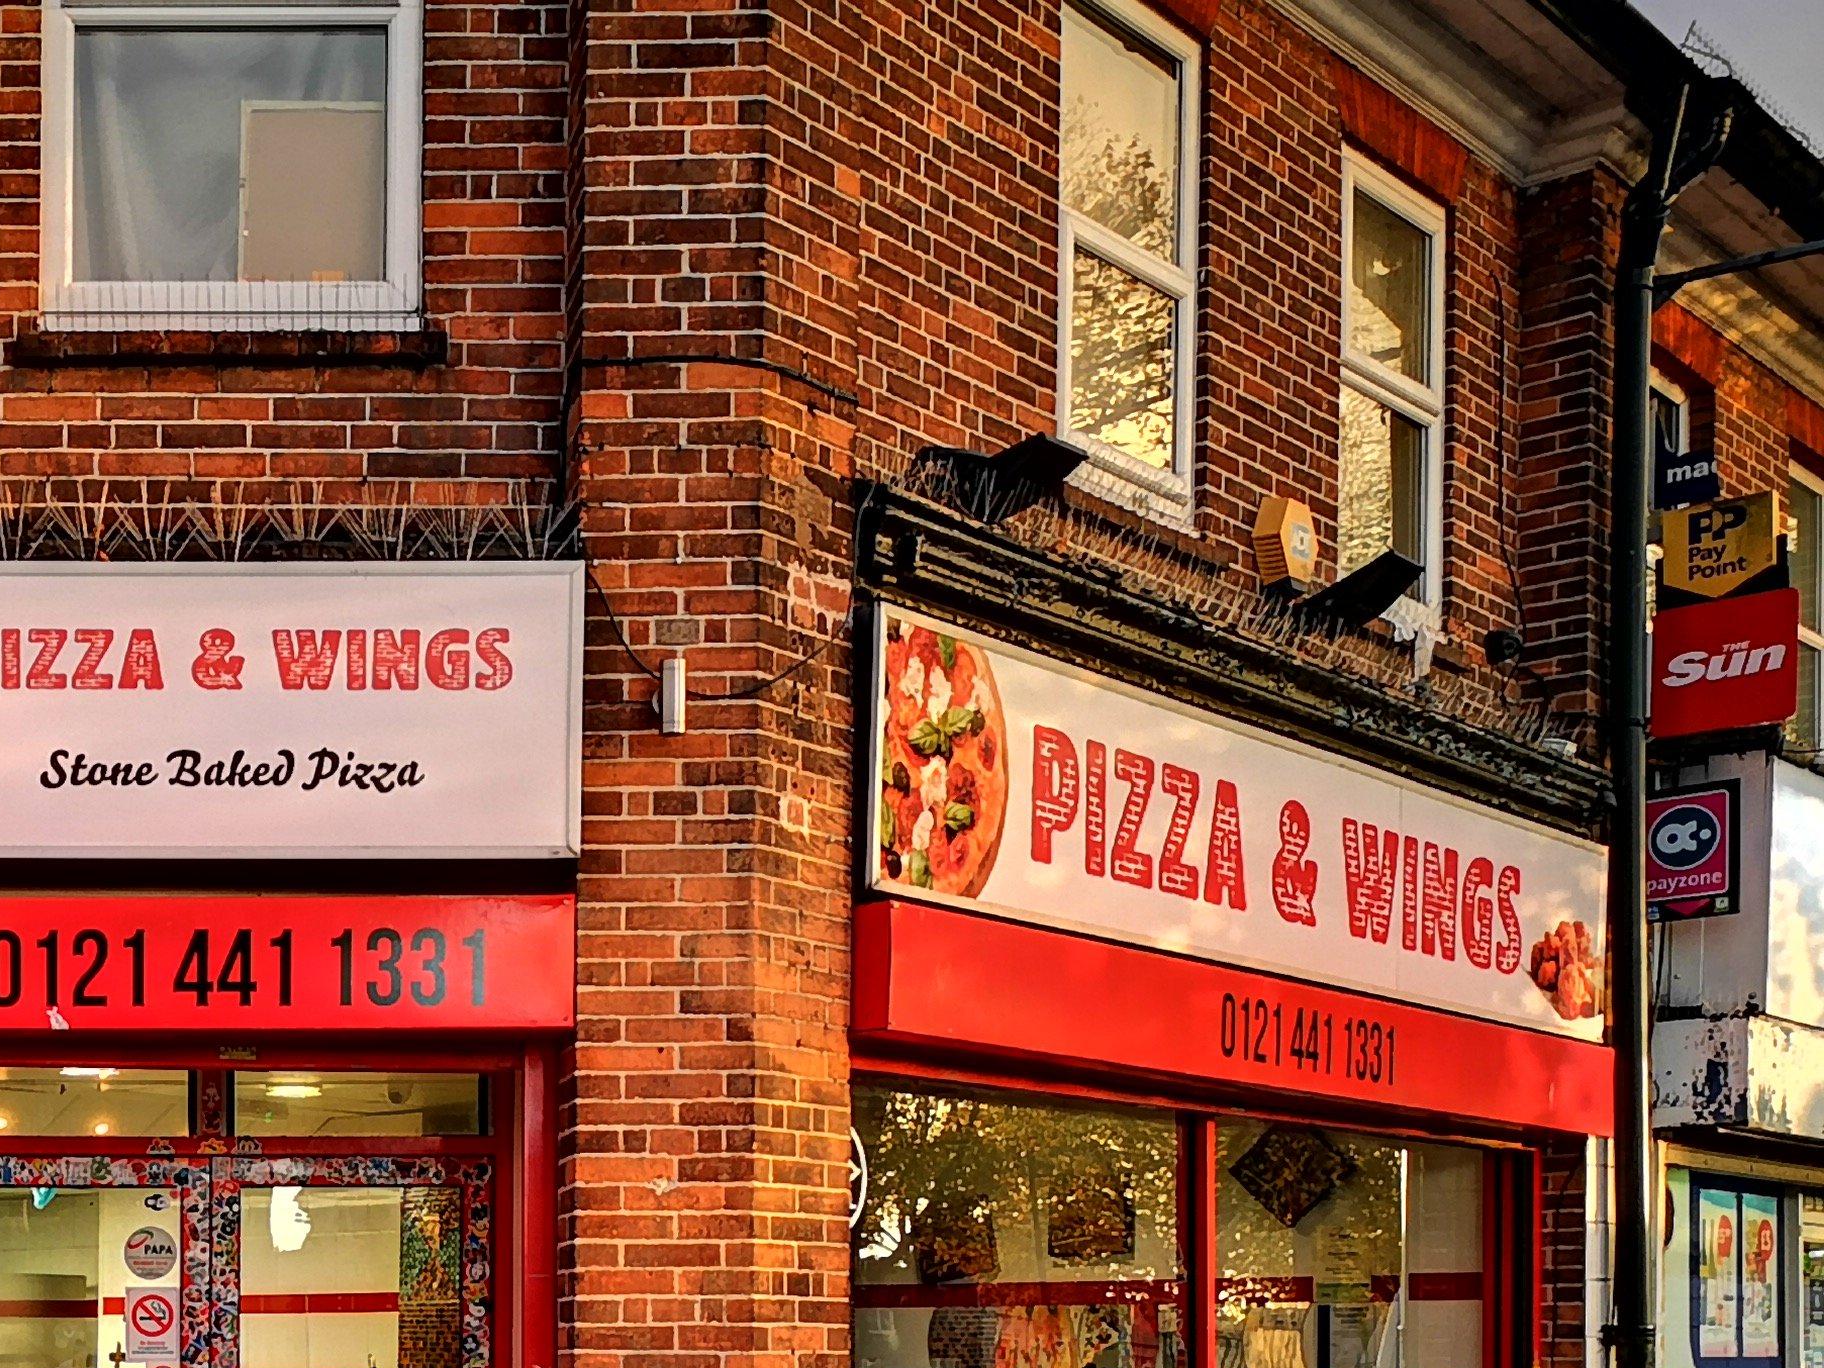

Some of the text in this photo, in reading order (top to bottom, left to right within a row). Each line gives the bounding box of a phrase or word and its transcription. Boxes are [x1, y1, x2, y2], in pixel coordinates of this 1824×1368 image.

[1689, 545, 1726, 563] Pay
[1689, 556, 1747, 581] Point
[192, 628, 245, 690] &
[272, 628, 513, 690] WINGS
[1662, 643, 1786, 687] Sun
[1722, 640, 1750, 652] THE
[39, 747, 425, 793] Stone Baked Pizza
[1031, 724, 1522, 974] PIZZA & WINGS
[1647, 869, 1723, 896] payzone
[173, 928, 293, 1007] 441
[331, 927, 486, 1007] 1331
[1221, 993, 1394, 1085] 0121 441 1331
[144, 1245, 173, 1255] PAPA
